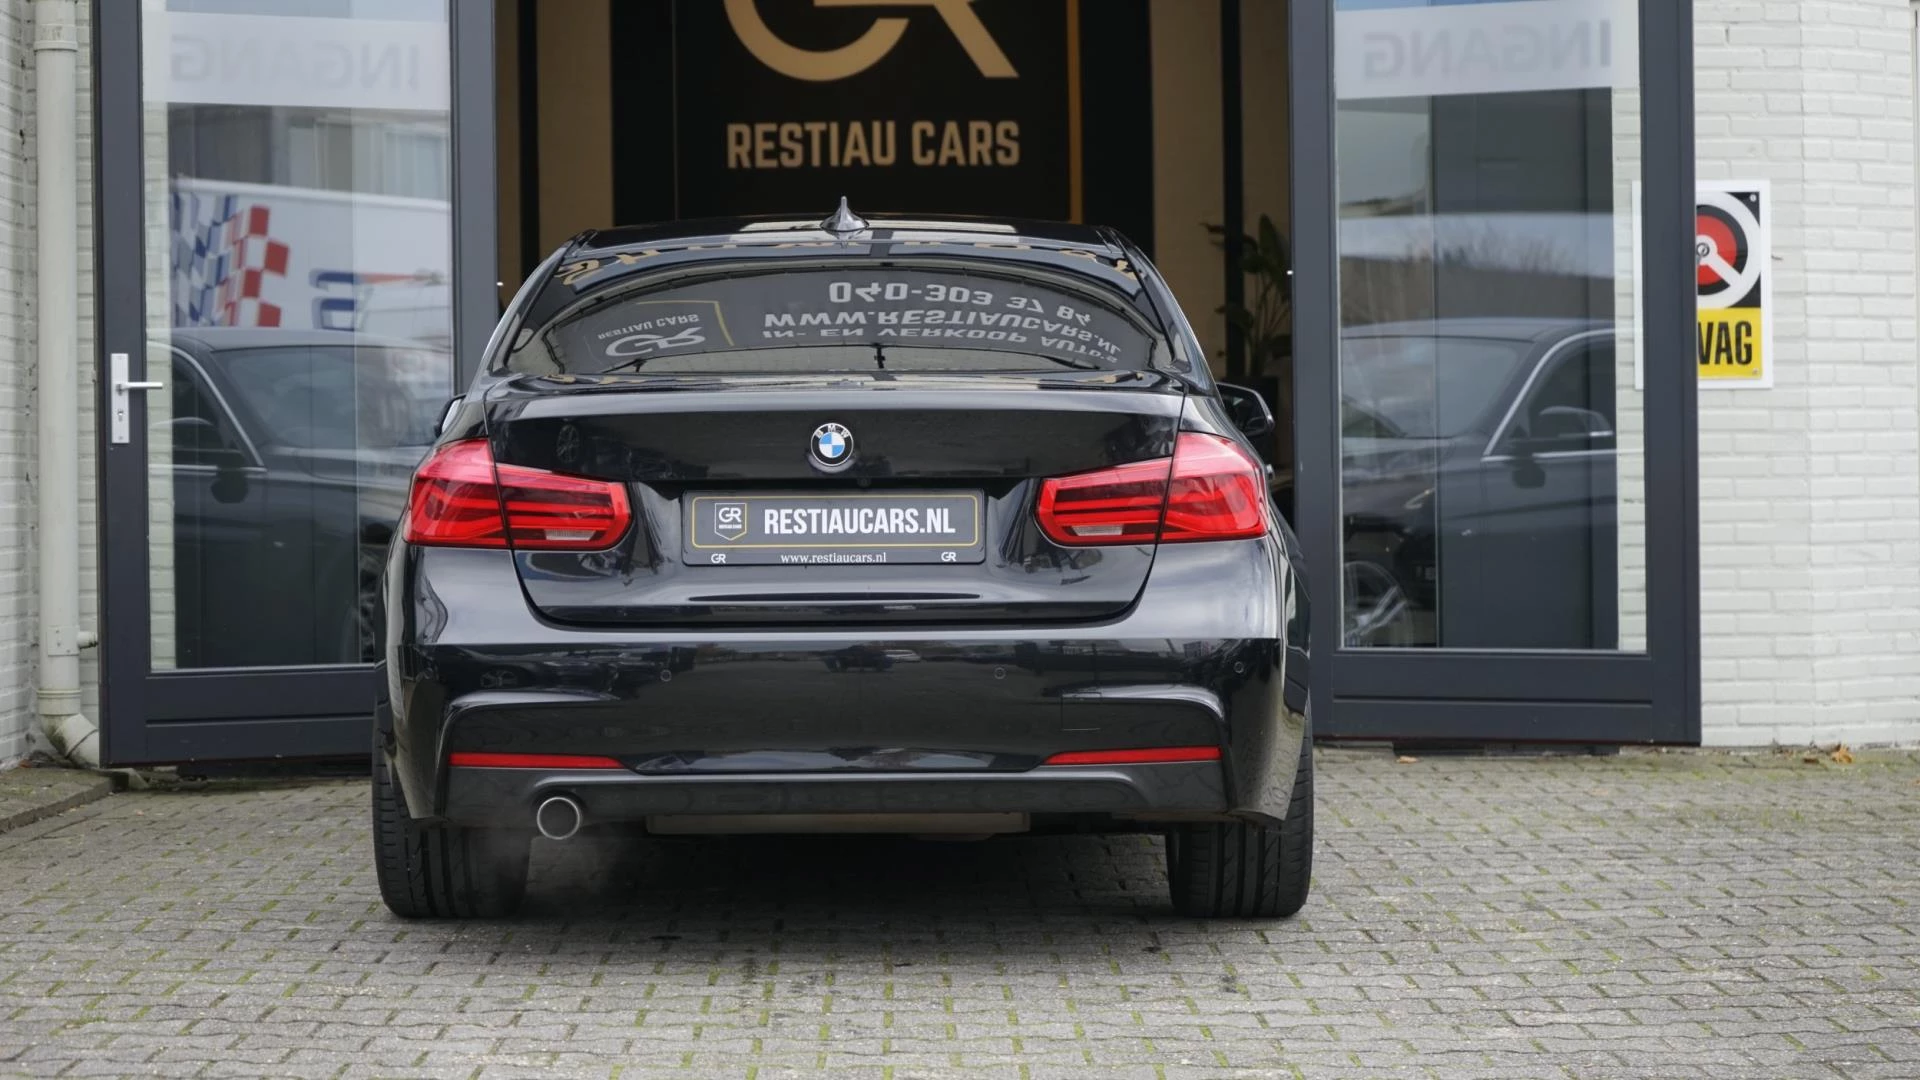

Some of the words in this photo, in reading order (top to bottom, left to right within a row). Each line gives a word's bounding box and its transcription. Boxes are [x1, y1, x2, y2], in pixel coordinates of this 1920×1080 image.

[727, 121, 896, 169] RESTIAU
[911, 121, 1020, 167] CARS
[1697, 320, 1753, 366] VAG
[815, 424, 850, 439] BMW
[718, 507, 742, 523] GR
[764, 507, 956, 534] RESTIAUCARS.NL
[711, 553, 727, 564] GR
[780, 552, 887, 563] www.restiaucars.nl
[940, 551, 957, 562] GR
